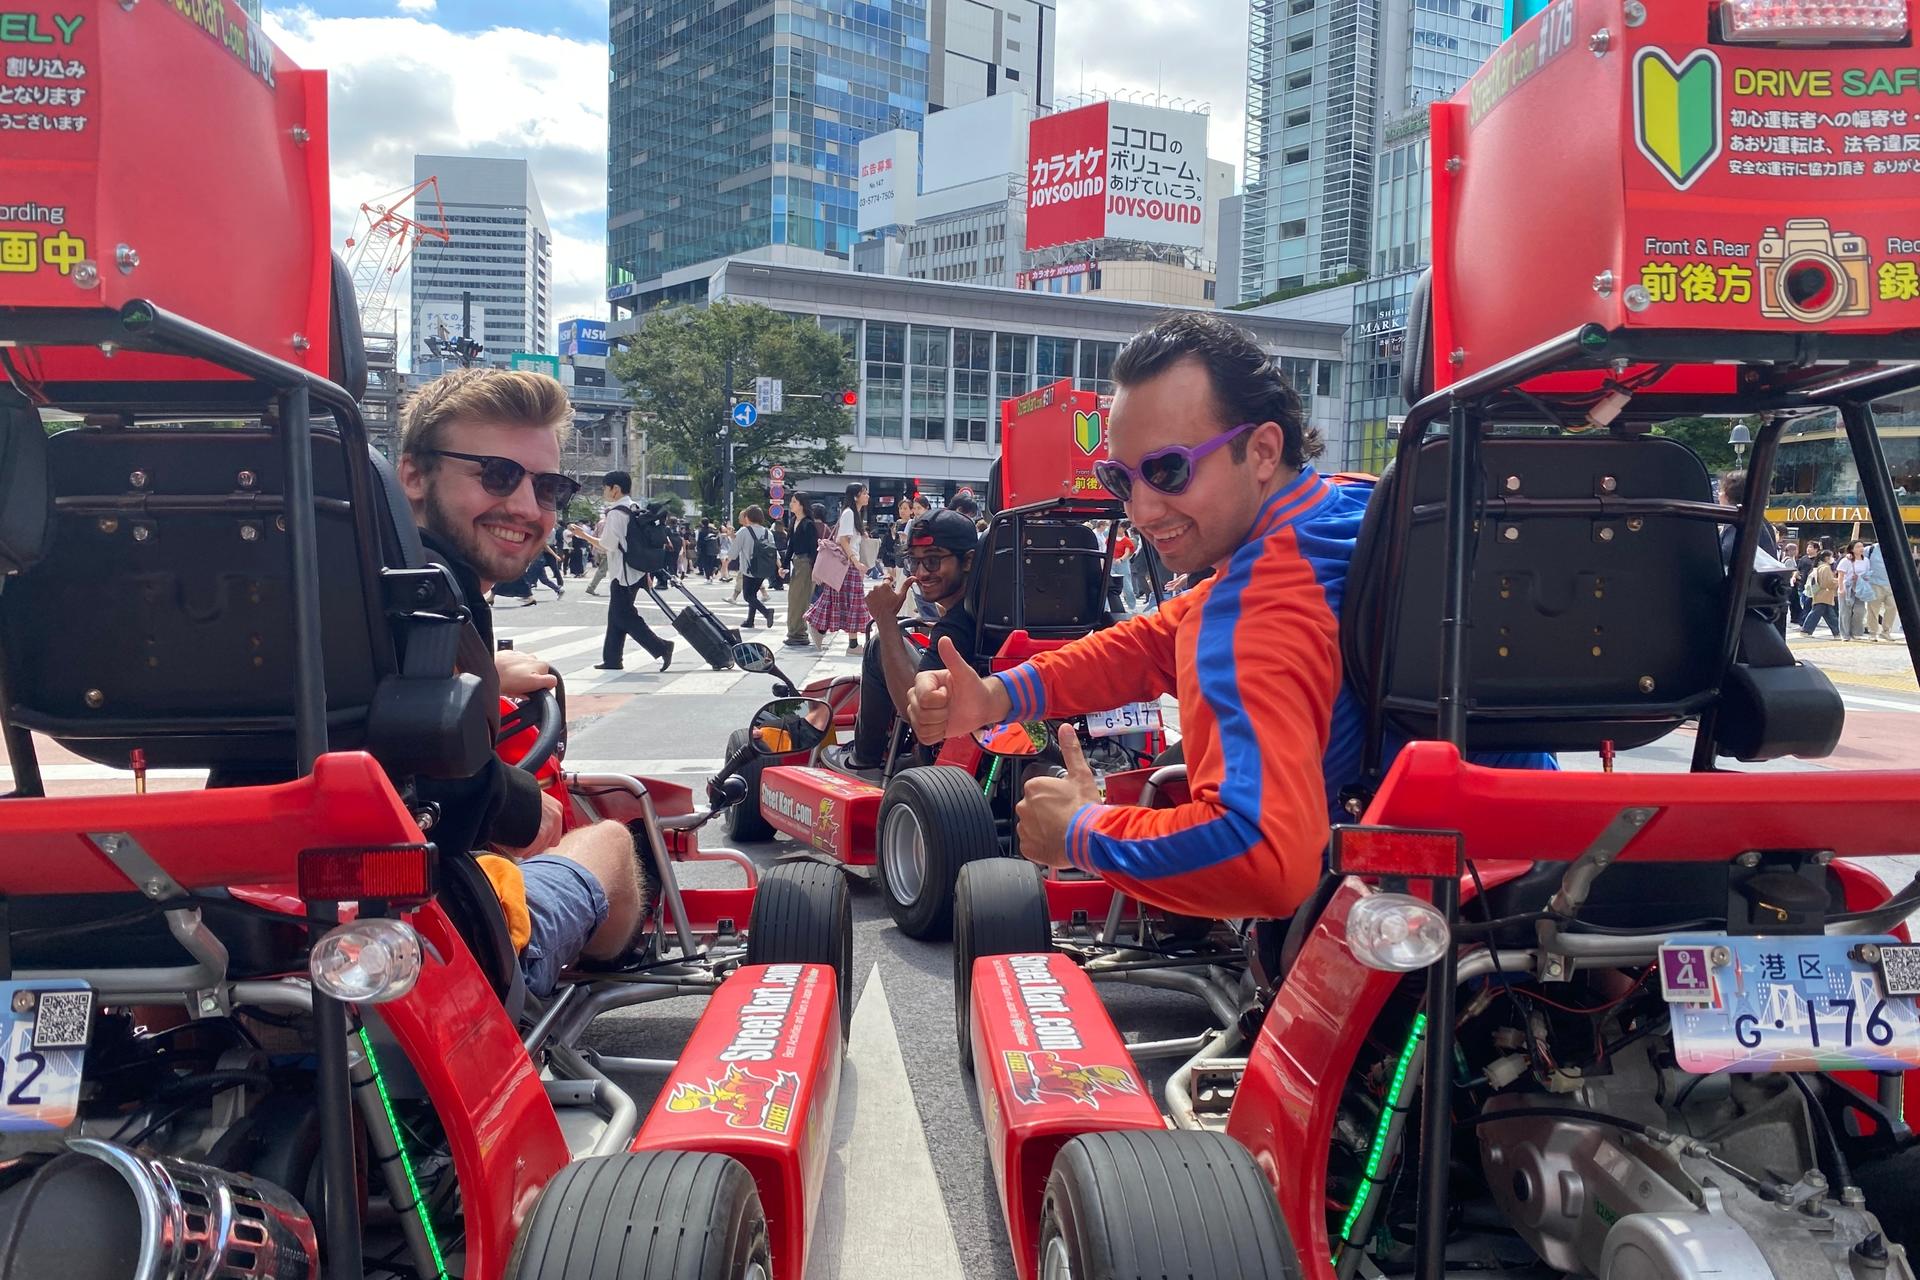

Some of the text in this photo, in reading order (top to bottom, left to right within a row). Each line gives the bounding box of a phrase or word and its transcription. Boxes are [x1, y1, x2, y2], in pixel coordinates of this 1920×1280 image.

[0, 14, 83, 43] ELY
[6, 56, 86, 79] 割り込み
[0, 84, 86, 107] となります
[1734, 68, 1920, 97] DRIVE SAF
[1111, 125, 1183, 155] ココロの
[1031, 147, 1104, 188] カラオケ
[1110, 150, 1202, 182] ボリューム、
[1030, 176, 1105, 209] JOYSOUND
[1110, 175, 1203, 202] あげていこう。
[0, 203, 64, 224] ording
[1107, 195, 1202, 225] JOYSOUND
[0, 230, 85, 275] 画中
[1645, 237, 1690, 255] Front
[1694, 238, 1708, 256] &
[1713, 239, 1751, 257] Rear
[1640, 261, 1920, 303] 前後方 録
[1360, 318, 1400, 334] MARK
[1075, 477, 1105, 490] 前後
[1677, 964, 1698, 988] 4
[0, 1051, 46, 1106] 2
